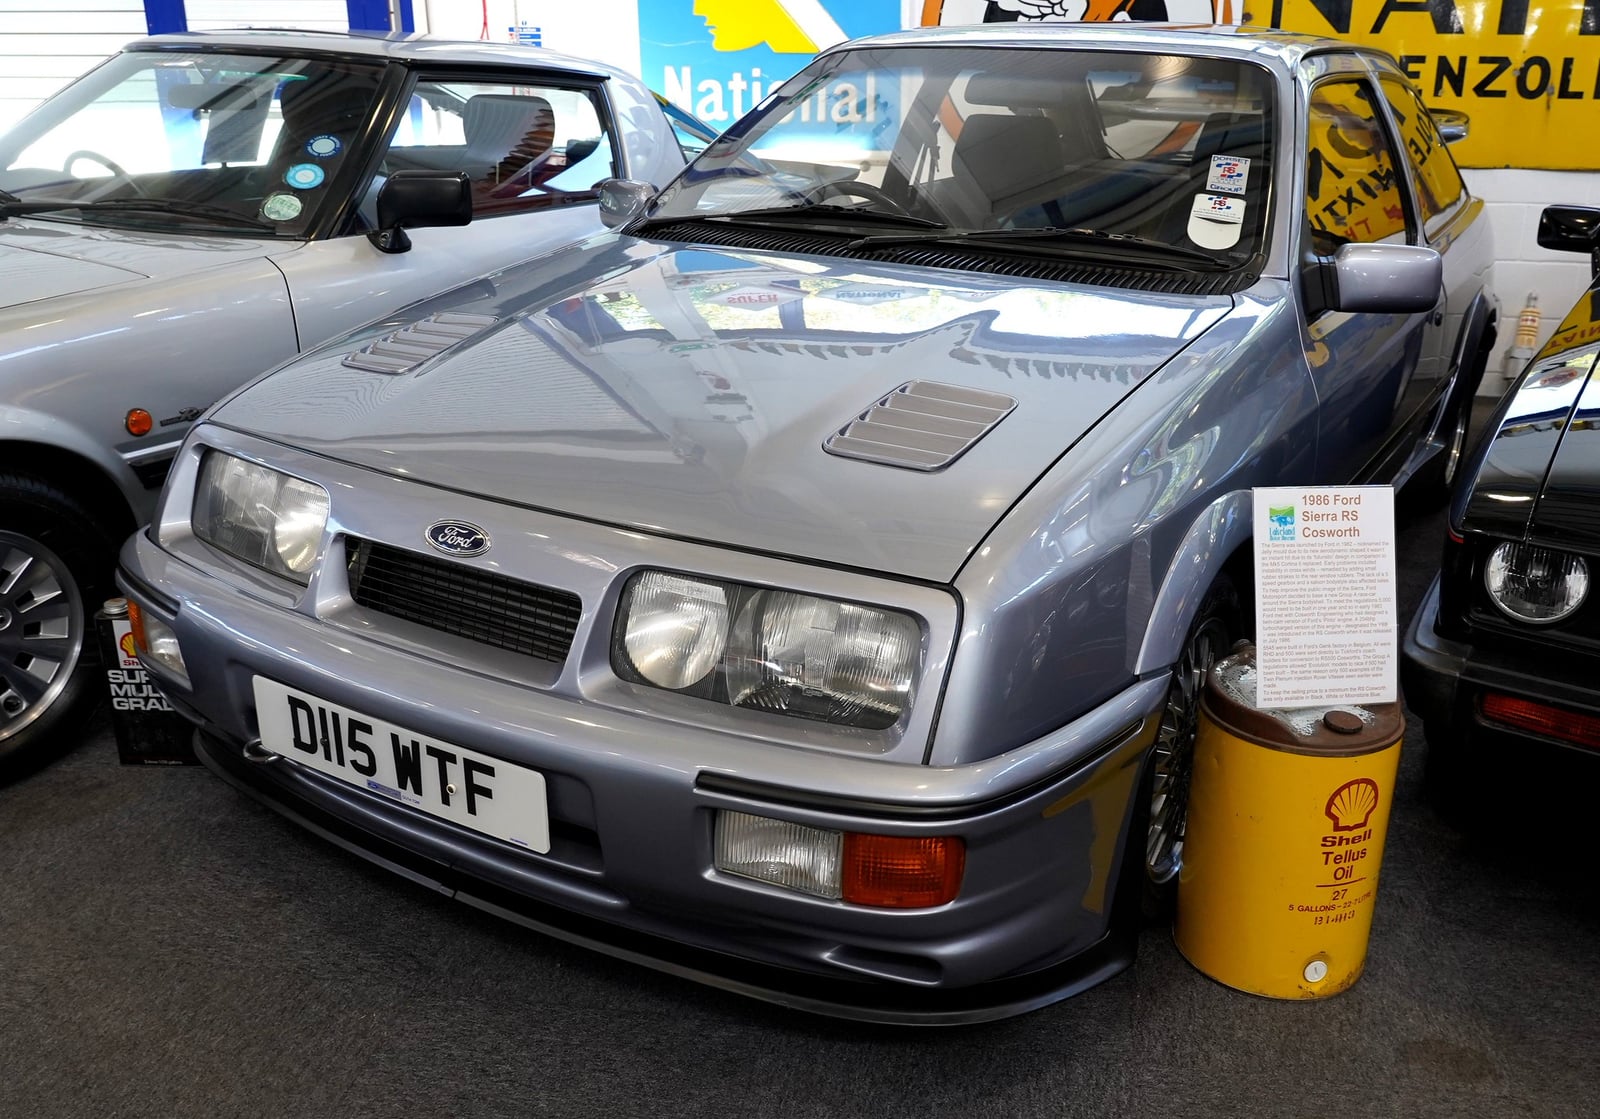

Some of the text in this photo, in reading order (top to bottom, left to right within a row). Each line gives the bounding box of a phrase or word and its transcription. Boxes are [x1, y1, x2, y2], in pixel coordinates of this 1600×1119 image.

[1399, 55, 1600, 100] ENZOL
[1209, 183, 1243, 192] GROUP
[1302, 494, 1361, 506] 1986 Ford
[1302, 510, 1359, 522] Sierra RS
[438, 526, 475, 548] Ford
[1302, 526, 1360, 538] Cosworth
[107, 669, 150, 683] SUP
[110, 684, 162, 697] MUL
[112, 698, 175, 711] GRA
[287, 695, 496, 817] D115 WTF
[1321, 829, 1372, 847] Shell
[1322, 847, 1367, 865] Tellus
[1333, 865, 1353, 881] Oil
[1332, 889, 1348, 901] 27
[1297, 904, 1336, 912] GALLONS
